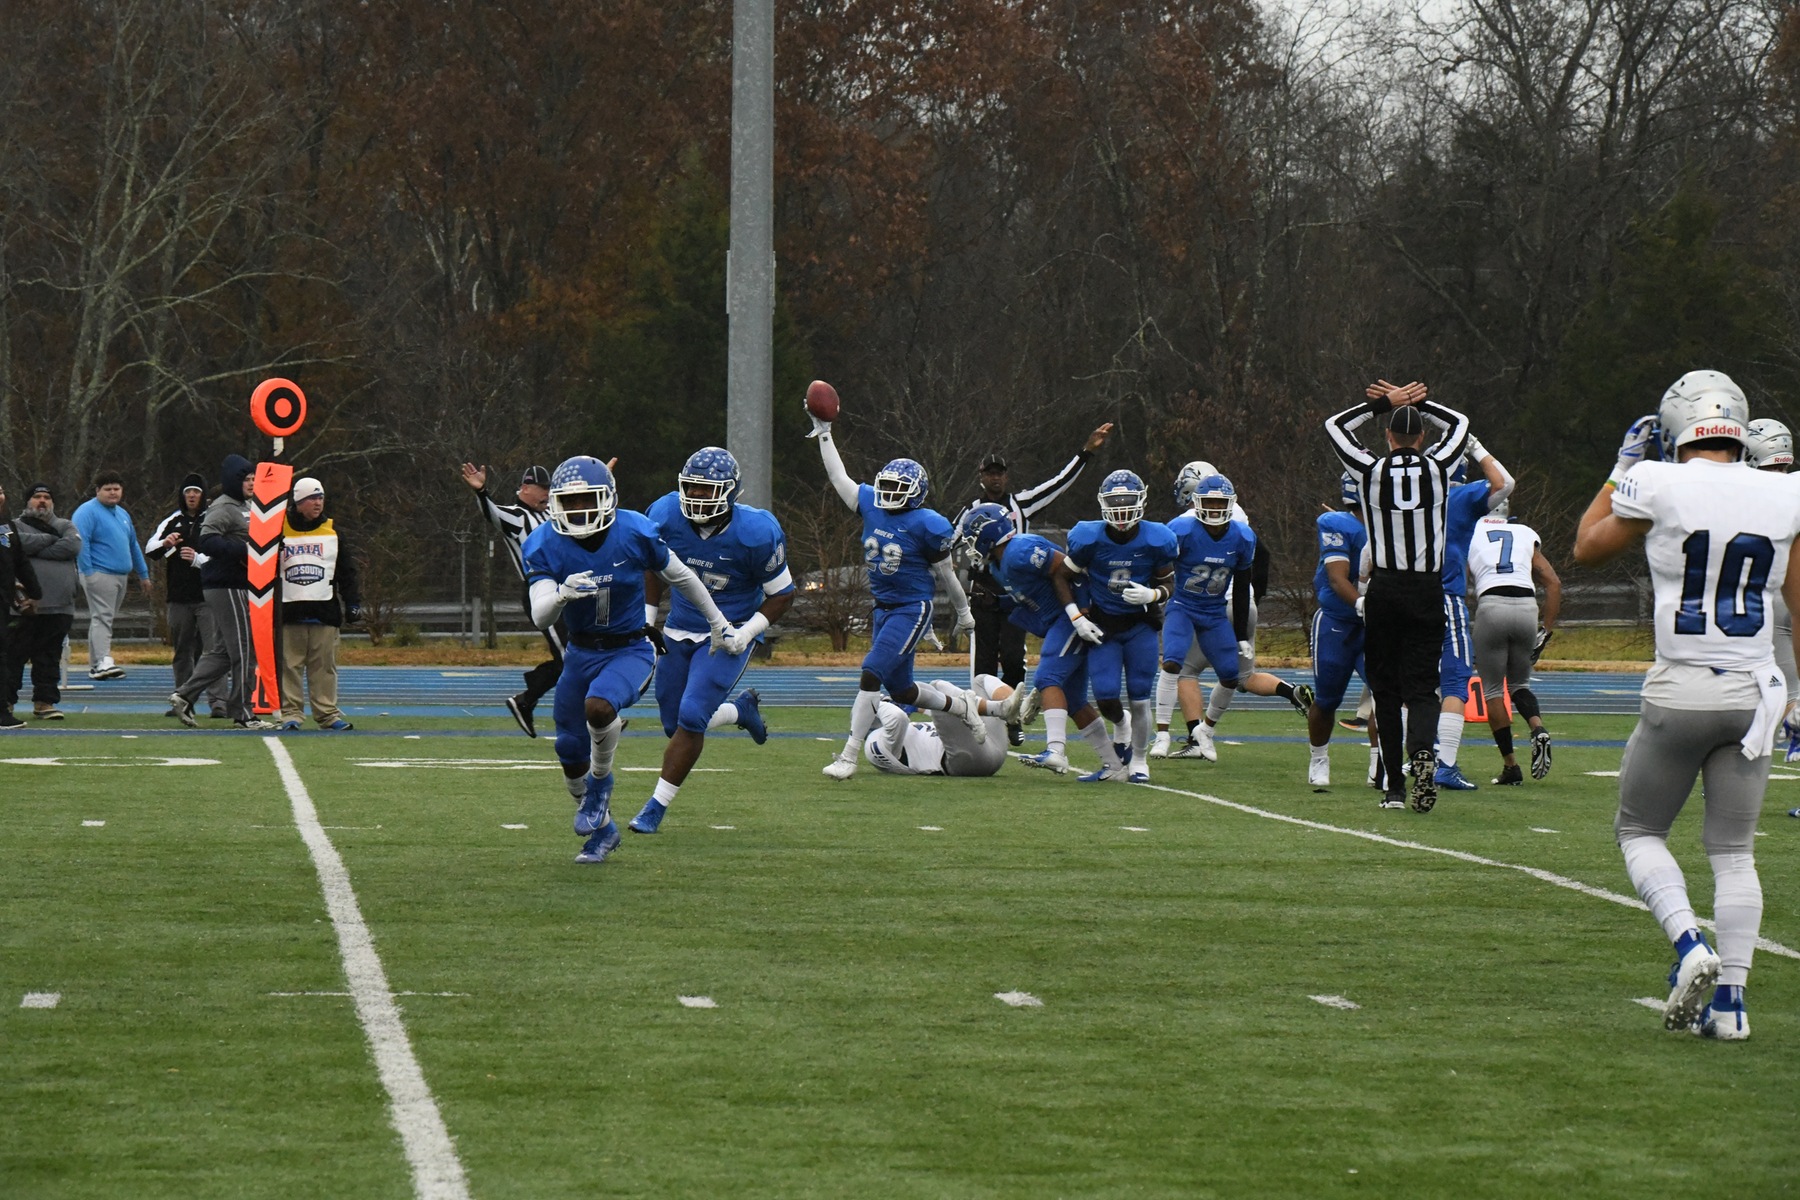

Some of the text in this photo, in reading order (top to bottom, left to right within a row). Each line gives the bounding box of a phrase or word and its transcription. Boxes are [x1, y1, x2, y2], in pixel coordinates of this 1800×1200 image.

[1695, 425, 1741, 437] Riddell
[1390, 467, 1422, 510] U
[283, 543, 324, 562] NAIA
[864, 535, 903, 576] 29
[1322, 532, 1344, 546] 53
[1486, 530, 1514, 574] 7
[686, 557, 714, 569] RAIDERS
[1183, 565, 1230, 596] 28
[1675, 530, 1776, 637] 10
[593, 587, 610, 627] 1
